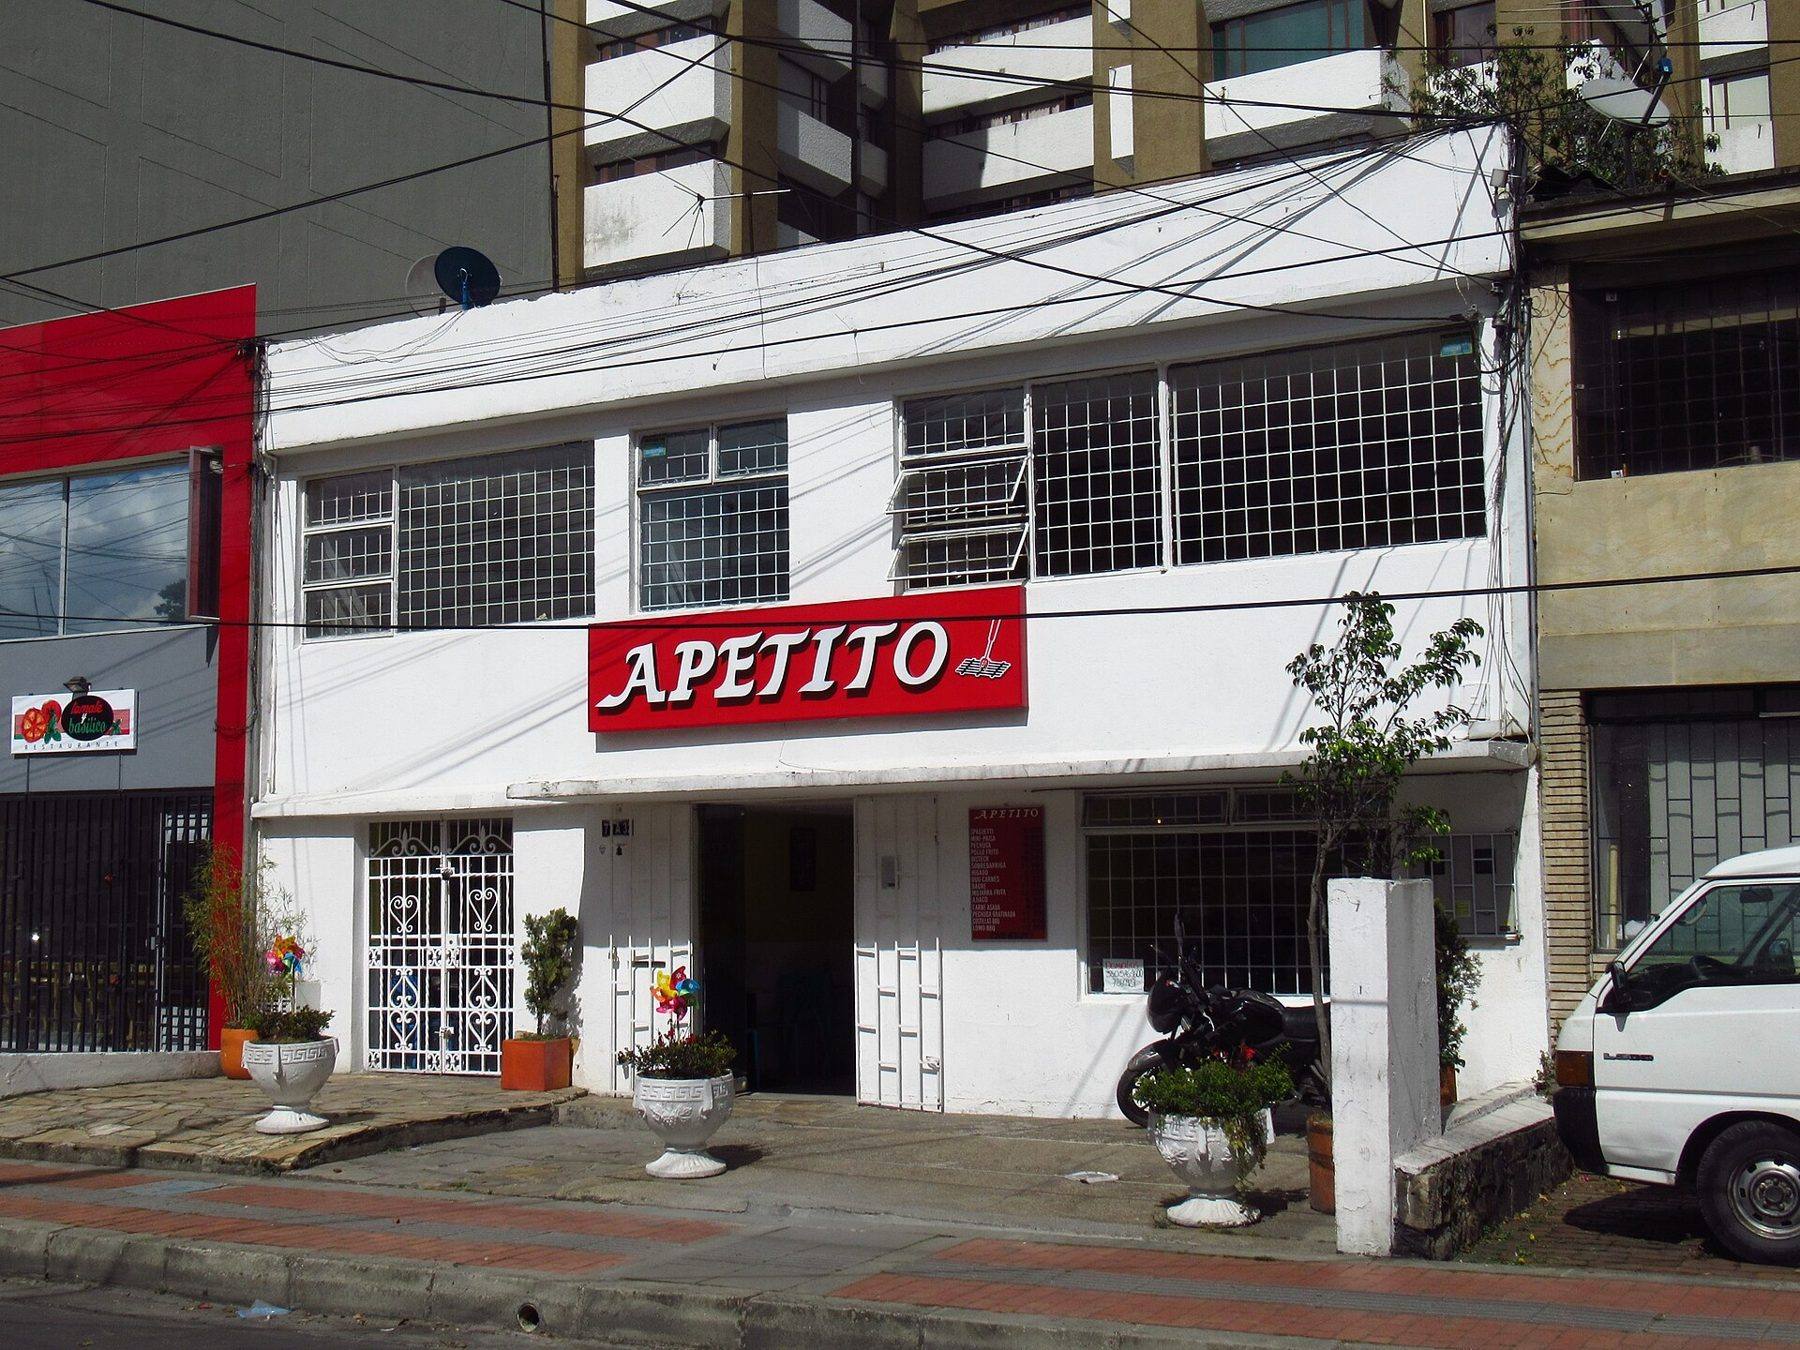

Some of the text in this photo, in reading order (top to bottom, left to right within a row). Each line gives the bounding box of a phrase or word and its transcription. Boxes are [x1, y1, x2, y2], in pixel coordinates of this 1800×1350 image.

[595, 620, 949, 709] APETITO
[24, 740, 118, 751] RESTAURANTE
[973, 808, 1039, 820] APETITO
